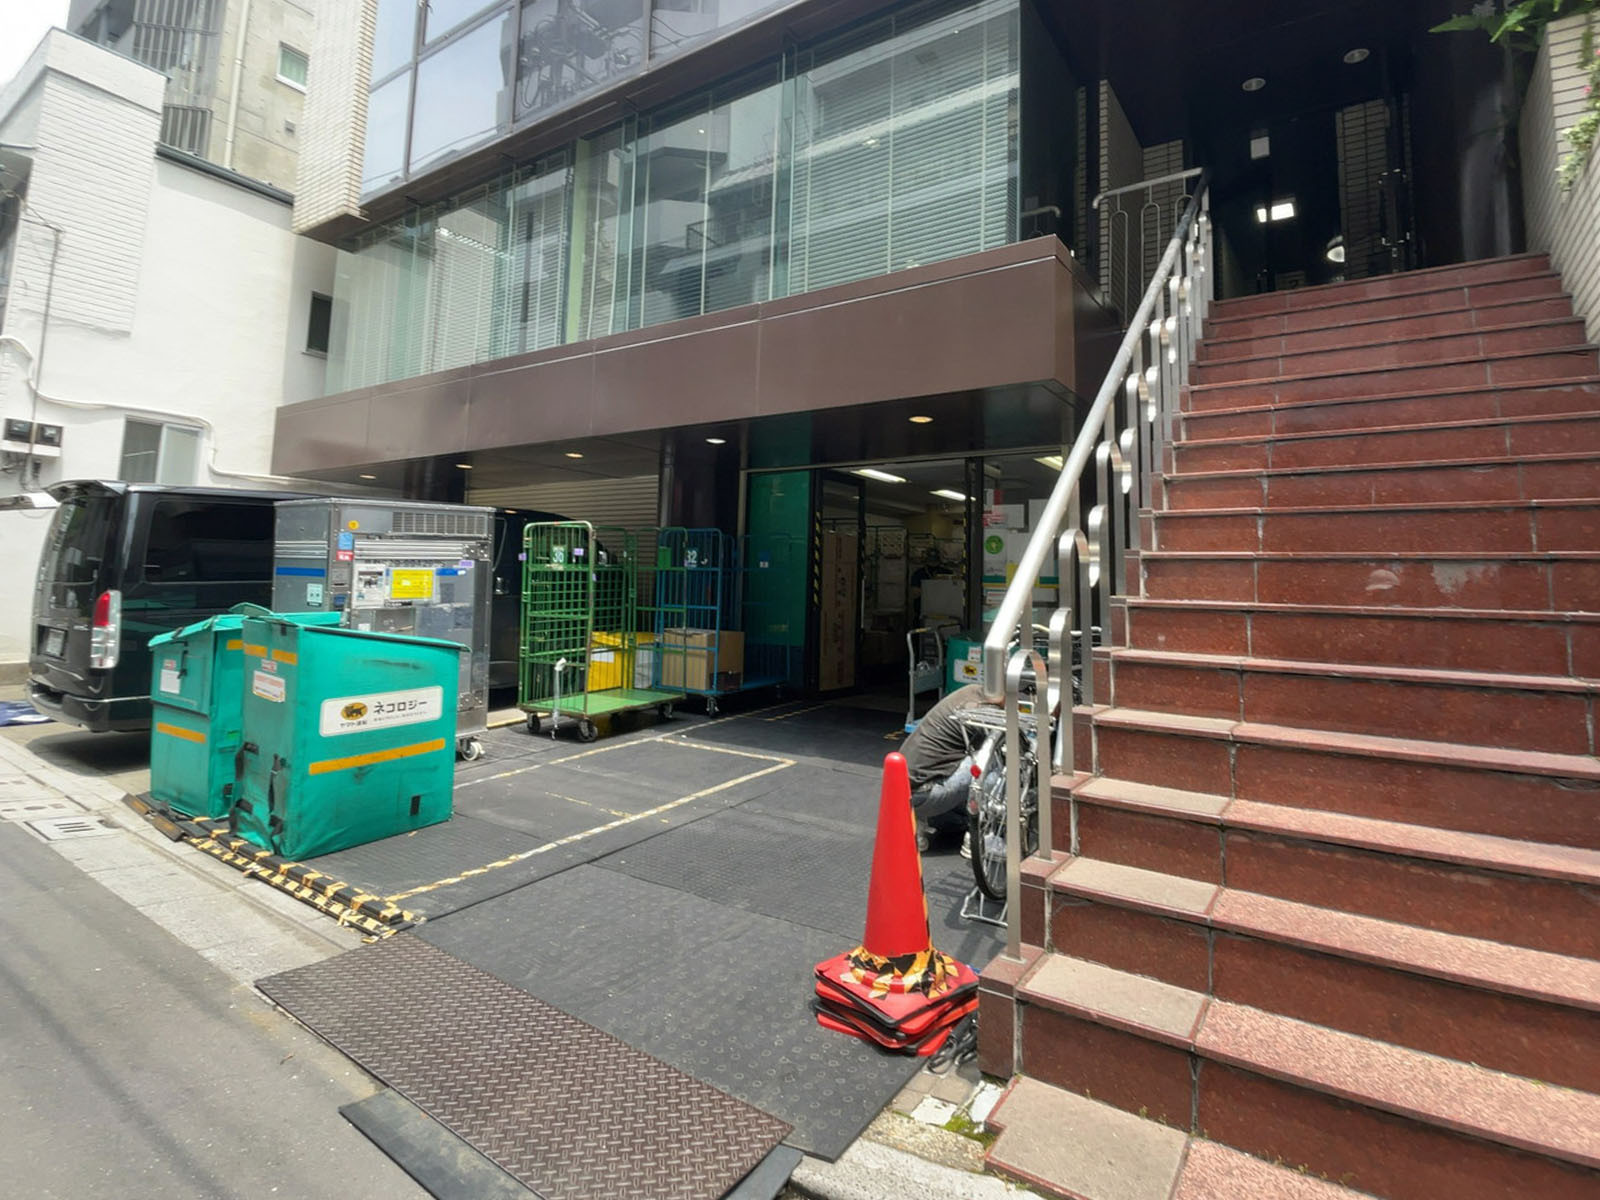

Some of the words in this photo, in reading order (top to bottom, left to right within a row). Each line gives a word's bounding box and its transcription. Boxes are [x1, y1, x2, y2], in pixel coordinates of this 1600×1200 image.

[373, 700, 428, 714] ネコロジー
